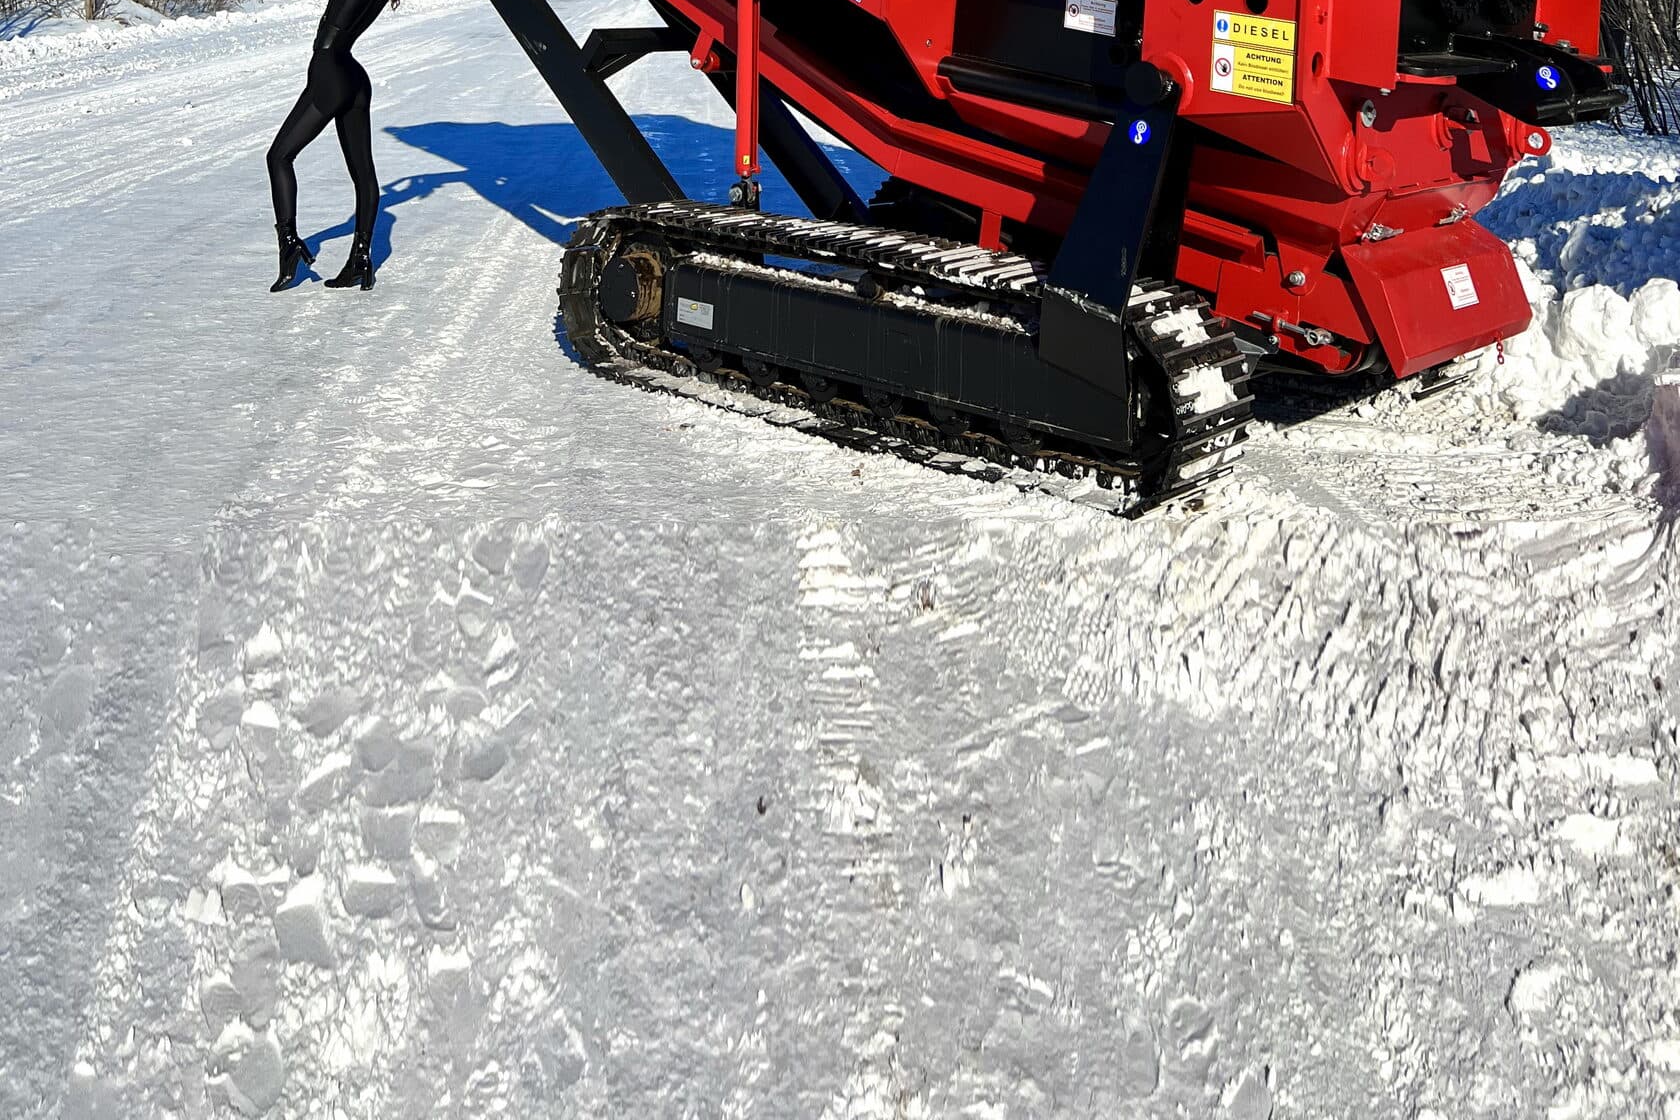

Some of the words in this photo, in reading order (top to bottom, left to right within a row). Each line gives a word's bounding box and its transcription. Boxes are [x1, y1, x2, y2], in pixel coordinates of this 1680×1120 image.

[1233, 22, 1289, 41] DIESEL
[1246, 52, 1282, 64] ACHTUNG
[1242, 74, 1283, 87] ATTENTION
